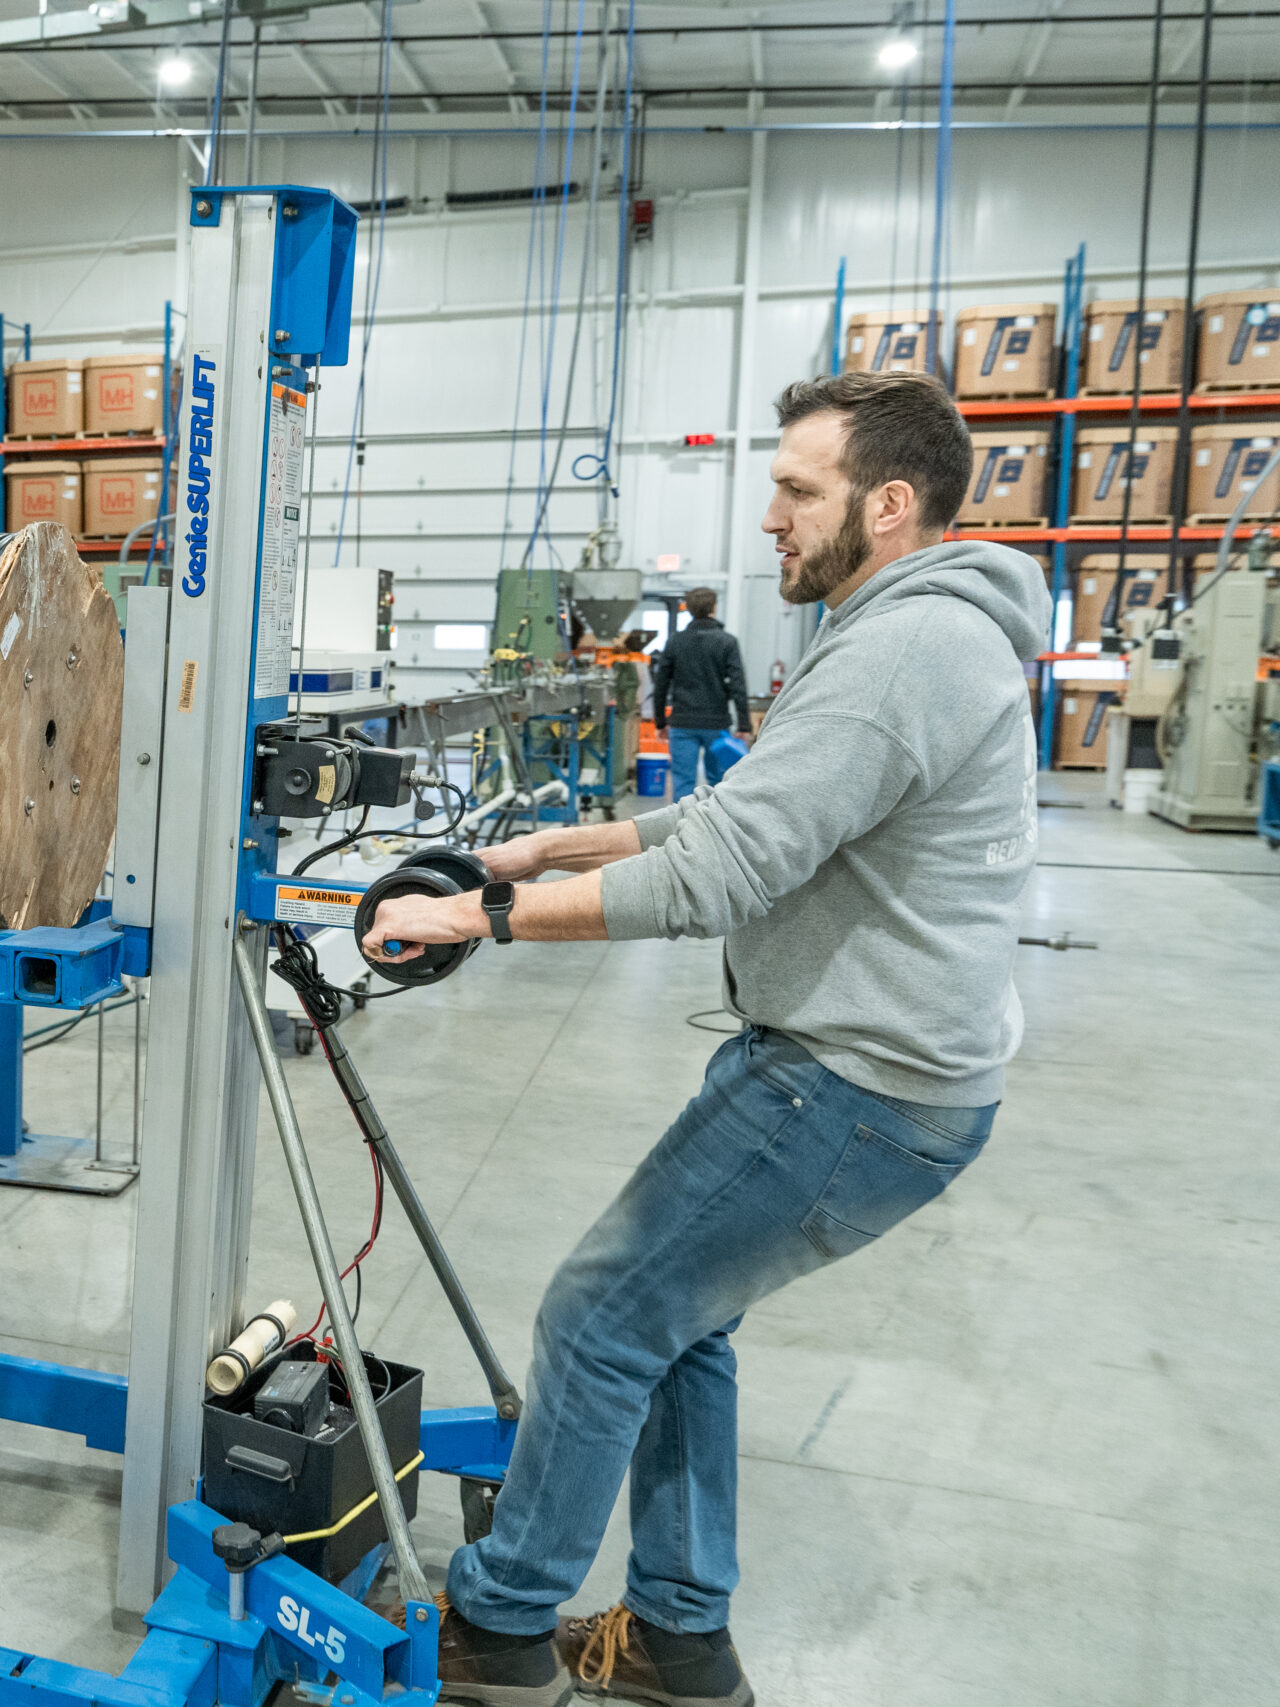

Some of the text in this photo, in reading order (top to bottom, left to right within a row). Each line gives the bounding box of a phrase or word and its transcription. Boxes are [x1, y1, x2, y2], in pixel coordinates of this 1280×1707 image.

[28, 392, 57, 410] MH
[103, 388, 134, 405] MH
[186, 354, 216, 516] SUPERLIFT
[26, 494, 56, 512] MH
[104, 491, 135, 509] MH
[182, 516, 208, 598] Genie
[306, 891, 352, 904] WARNING
[277, 1595, 347, 1664] SL-5
